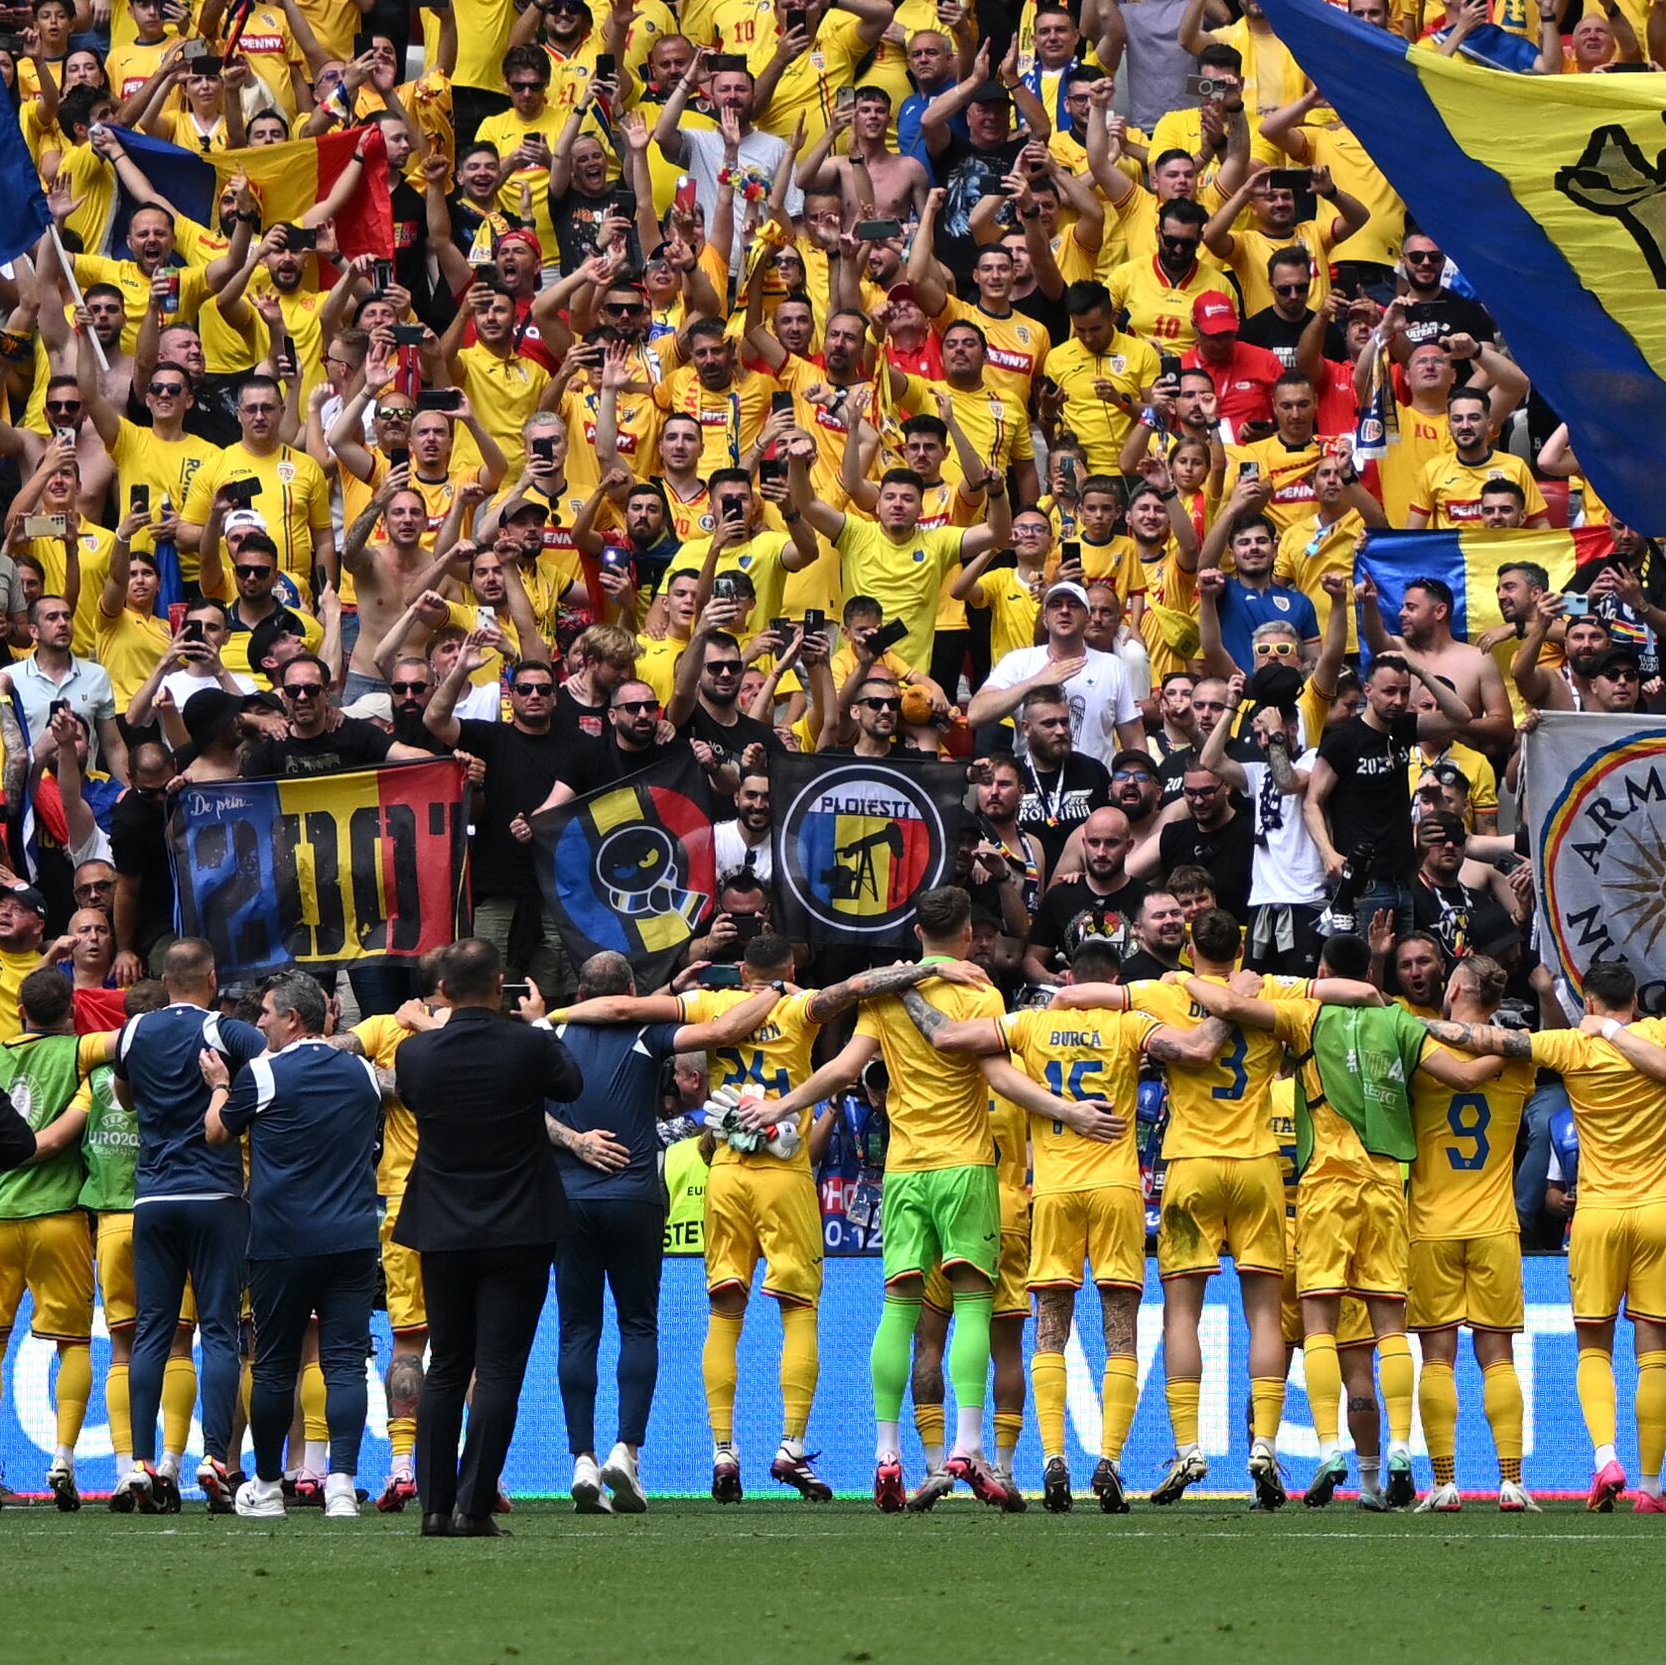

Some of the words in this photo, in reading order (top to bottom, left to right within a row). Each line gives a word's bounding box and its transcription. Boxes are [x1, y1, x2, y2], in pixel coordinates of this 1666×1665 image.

[238, 35, 284, 50] PENNY.
[734, 19, 755, 44] 10
[1153, 314, 1181, 339] 10
[542, 533, 572, 545] ENN
[187, 790, 211, 816] De
[1049, 1028, 1102, 1048] BURCĂ
[1211, 1030, 1248, 1100] 3
[1447, 1093, 1491, 1170] 9
